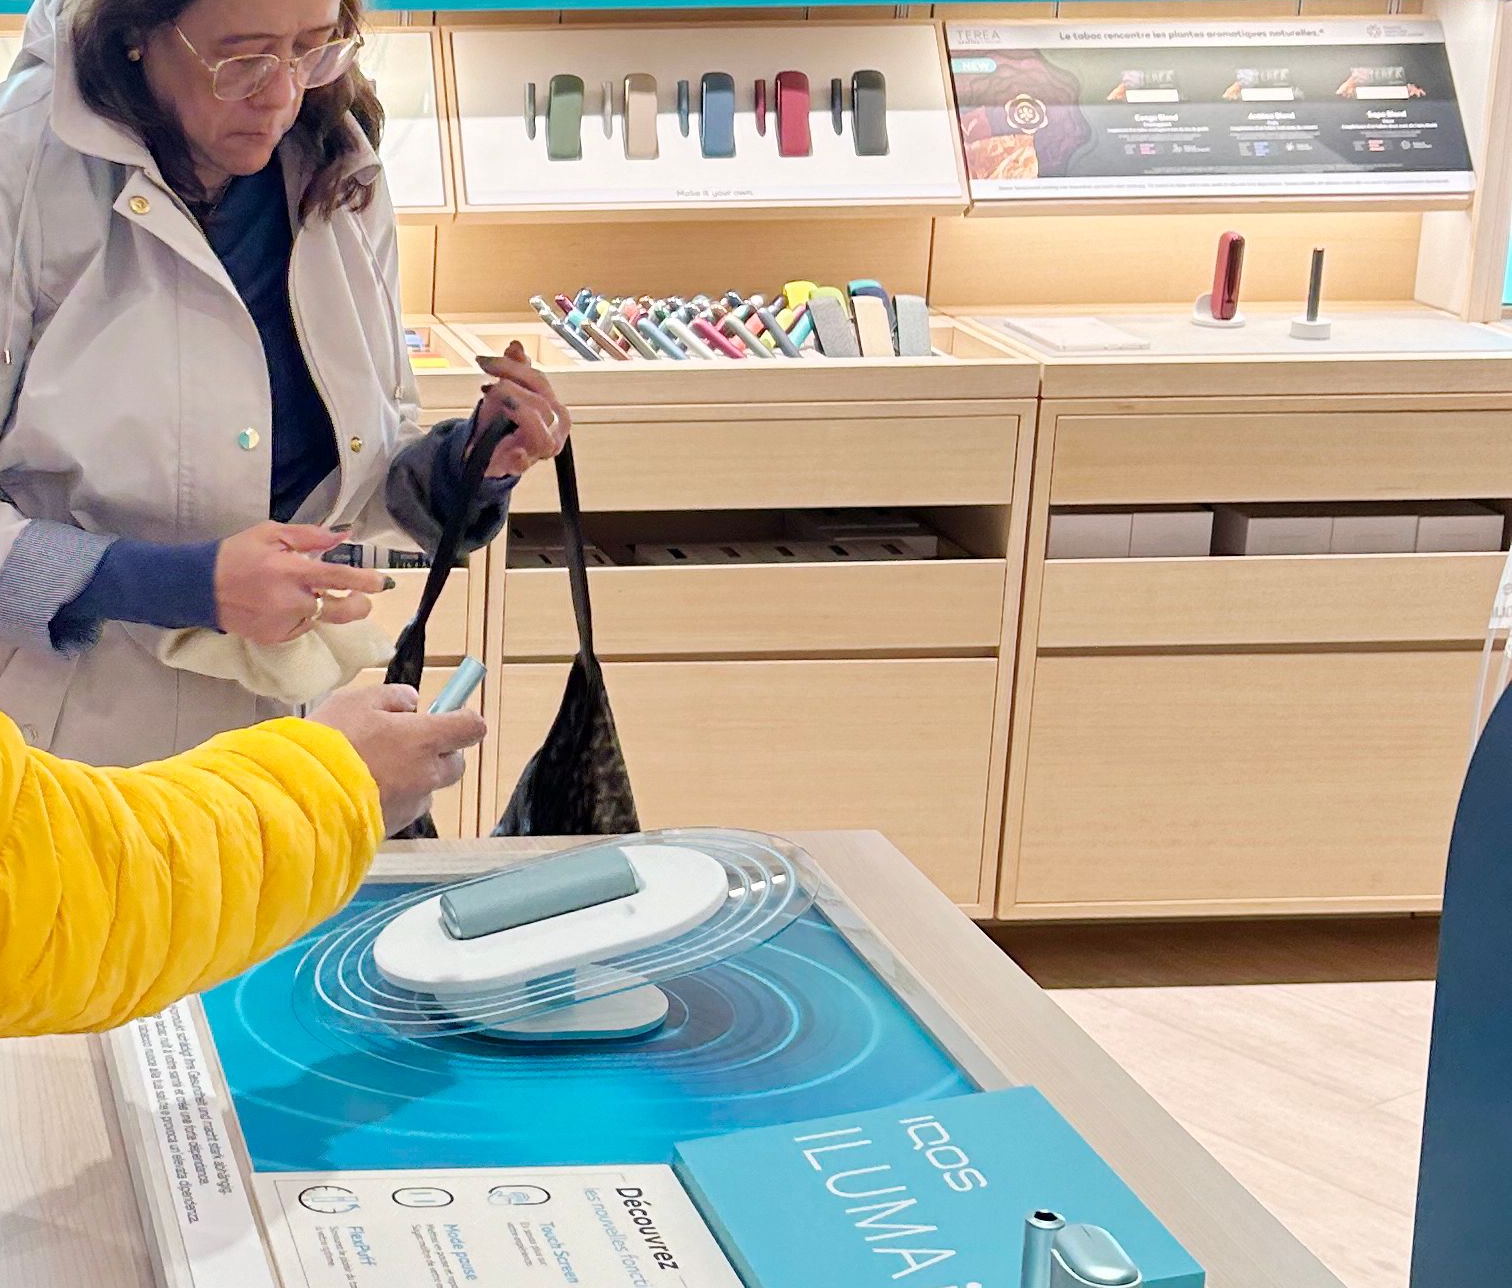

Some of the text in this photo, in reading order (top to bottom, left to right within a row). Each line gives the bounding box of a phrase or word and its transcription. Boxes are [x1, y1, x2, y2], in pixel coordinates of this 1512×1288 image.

[1073, 29, 1267, 42] tabac rencontre plantes aromatiques
[962, 62, 989, 72] NEW
[899, 1115, 987, 1192] IQOS
[583, 1187, 602, 1215] les
[793, 1126, 957, 1280] ILUMA
[348, 1225, 375, 1267] FlexPuff
[443, 1223, 478, 1282] Mode pause
[539, 1222, 579, 1284] Touch Screen
[591, 1212, 629, 1260] nouvelles
[616, 1187, 679, 1272] Découvrez
